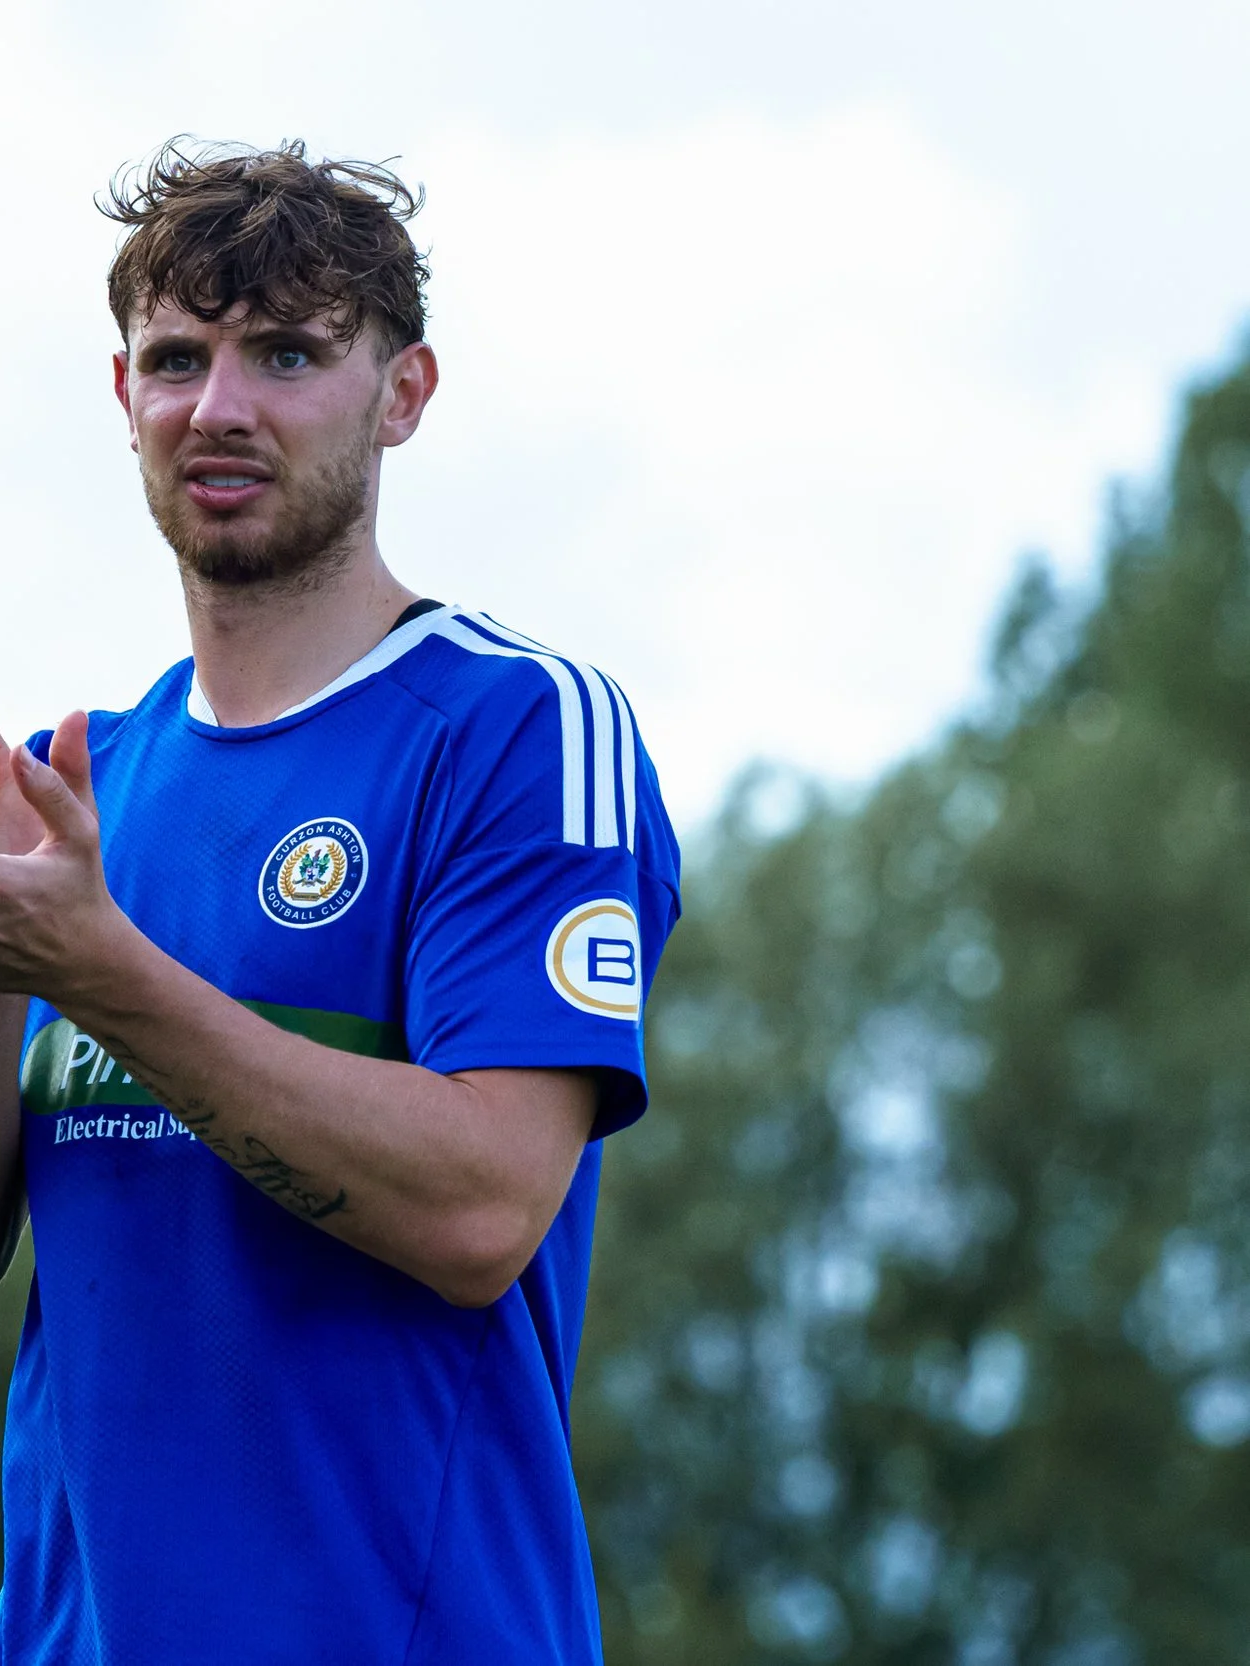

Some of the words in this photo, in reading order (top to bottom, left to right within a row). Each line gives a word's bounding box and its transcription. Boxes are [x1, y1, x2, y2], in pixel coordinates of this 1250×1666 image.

[275, 825, 324, 861] CURZON
[328, 825, 361, 863] ASHTON
[266, 886, 315, 920] FOOTBALL
[321, 889, 352, 915] CLUB
[54, 1113, 165, 1145] Electrical
[167, 1113, 197, 1142] Su
